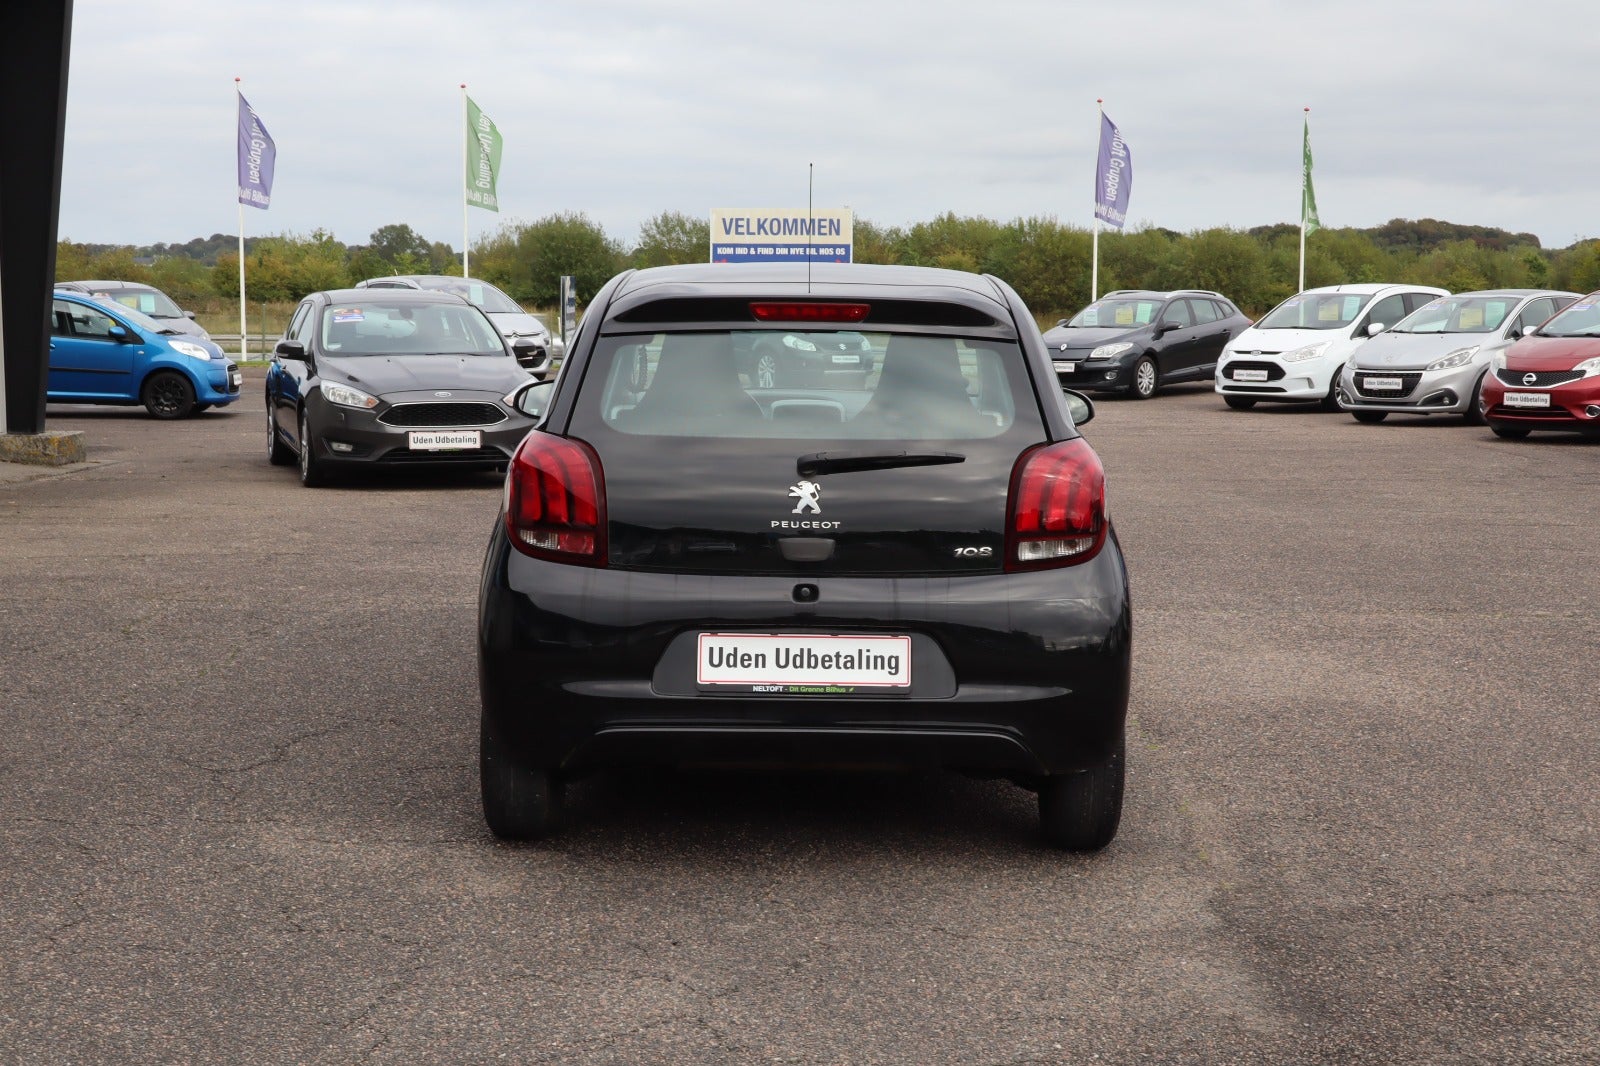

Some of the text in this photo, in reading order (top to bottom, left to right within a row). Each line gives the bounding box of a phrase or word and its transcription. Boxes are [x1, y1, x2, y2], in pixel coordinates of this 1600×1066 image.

[248, 139, 266, 184] Gruppen
[1105, 157, 1125, 201] Gruppen
[722, 217, 840, 236] VELKOMMEN
[717, 247, 846, 255] KOM IND & FIND DIN NYE BIL HOS OS
[1519, 395, 1548, 404] Udbetaling
[413, 436, 477, 444] Uden Udbetaling
[770, 520, 841, 529] PEUGEOT
[953, 546, 993, 558] 108
[708, 646, 900, 675] Uden Udbetaling
